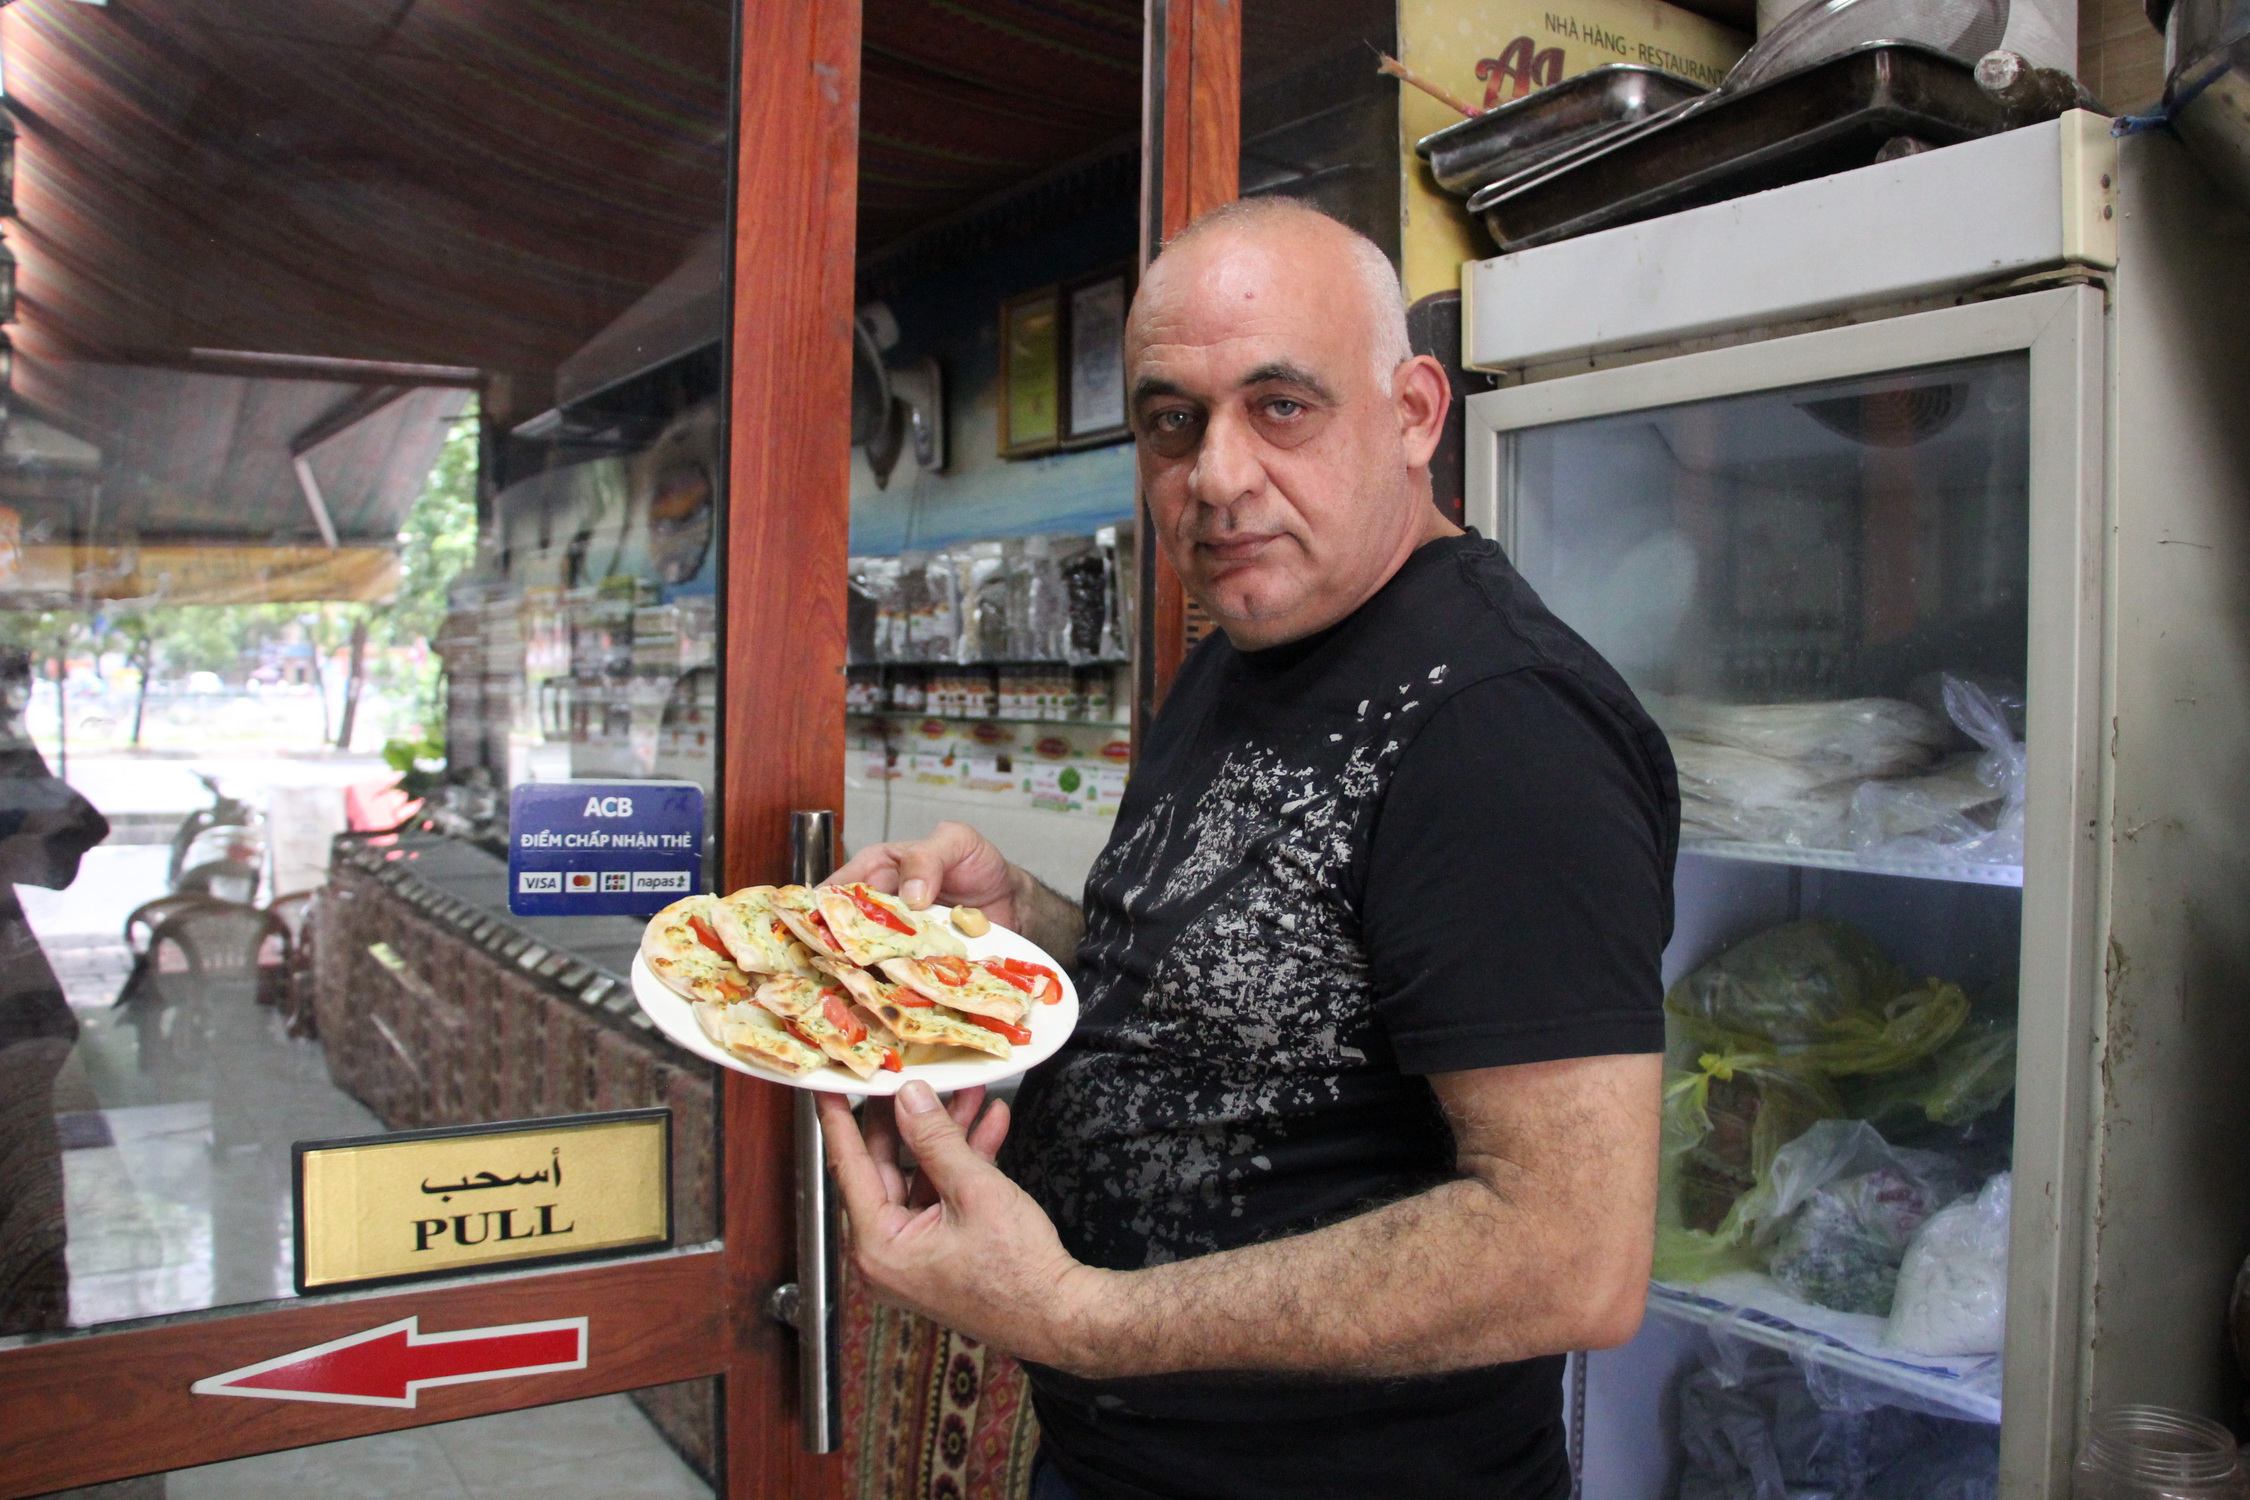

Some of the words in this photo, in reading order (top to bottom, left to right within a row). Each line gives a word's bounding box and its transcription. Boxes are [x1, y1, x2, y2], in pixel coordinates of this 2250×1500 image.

[1545, 12, 1579, 41] NHÀ
[1583, 24, 1627, 56] HÀNG
[1638, 43, 1726, 85] RESTAURANT
[583, 796, 633, 818] ACB
[521, 829, 562, 848] ĐIỂM
[565, 830, 610, 848] CHẤP
[612, 831, 659, 850] NHẬN
[661, 831, 692, 848] THẺ
[524, 877, 557, 889] VISA
[637, 877, 675, 890] napas
[410, 1203, 575, 1252] PULL
